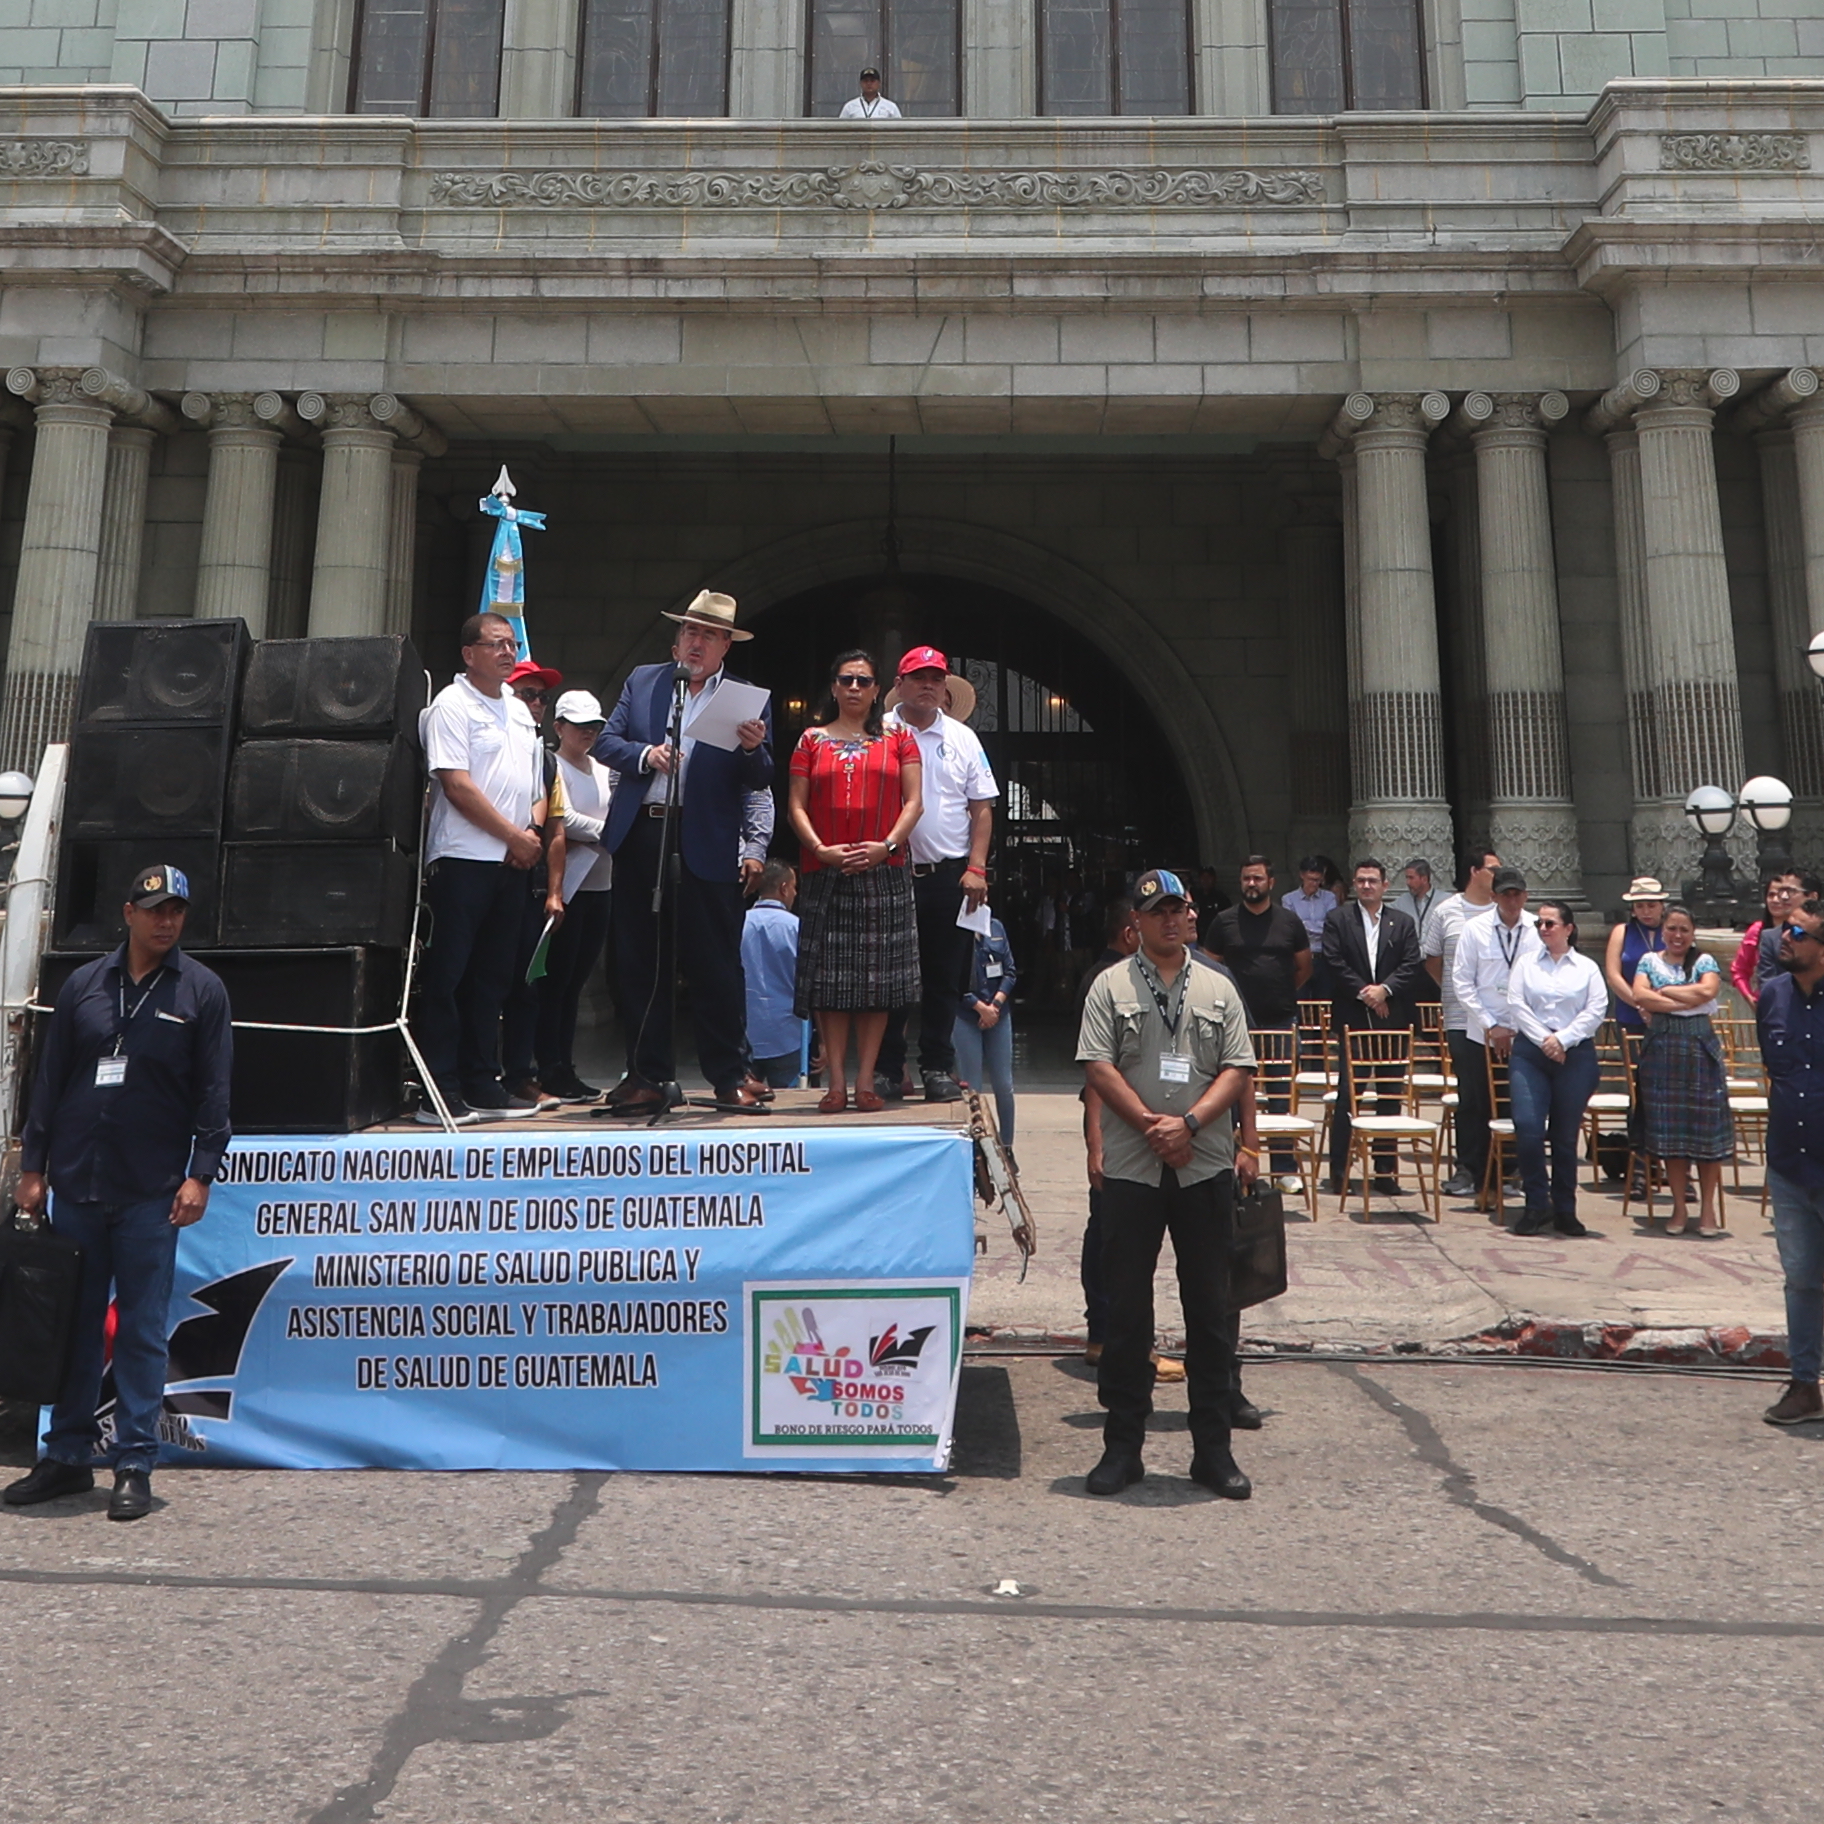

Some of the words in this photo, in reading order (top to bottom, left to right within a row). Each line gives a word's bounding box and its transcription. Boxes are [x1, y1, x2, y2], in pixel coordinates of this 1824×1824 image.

[216, 1149, 336, 1183] SINDICATO
[342, 1148, 459, 1181] NACIONAL
[465, 1148, 495, 1180] DE
[502, 1144, 642, 1178] EMPLEADOS
[649, 1144, 693, 1175] DEL
[699, 1142, 811, 1175] HOSPITAL
[256, 1202, 361, 1236] GENERAL
[369, 1201, 416, 1234] SAN
[422, 1199, 481, 1233] JUAN
[488, 1198, 518, 1232] DE
[524, 1197, 578, 1231] DIOS
[586, 1197, 616, 1230] DE
[622, 1194, 764, 1229] GUATEMALA
[314, 1253, 451, 1288] MINISTERIO
[457, 1252, 489, 1285] DE
[494, 1251, 571, 1284] SALUD
[578, 1249, 678, 1283] PUBLICA
[684, 1248, 700, 1281] Y
[287, 1305, 425, 1338] ASISTENCIA
[432, 1304, 516, 1337] SOCIAL
[521, 1304, 537, 1335] Y
[543, 1301, 728, 1335] TRABAJADORES
[357, 1357, 388, 1389] DE
[393, 1356, 471, 1389] SALUD
[477, 1355, 508, 1388] DE
[514, 1354, 658, 1388] GUATEMALA
[764, 1353, 864, 1379] SALUD
[831, 1380, 905, 1402] SOMOS
[831, 1401, 904, 1420] TODOS
[774, 1424, 806, 1434] BONO
[808, 1424, 823, 1434] DE
[826, 1424, 865, 1434] RIESGO
[897, 1424, 934, 1435] TODOS
